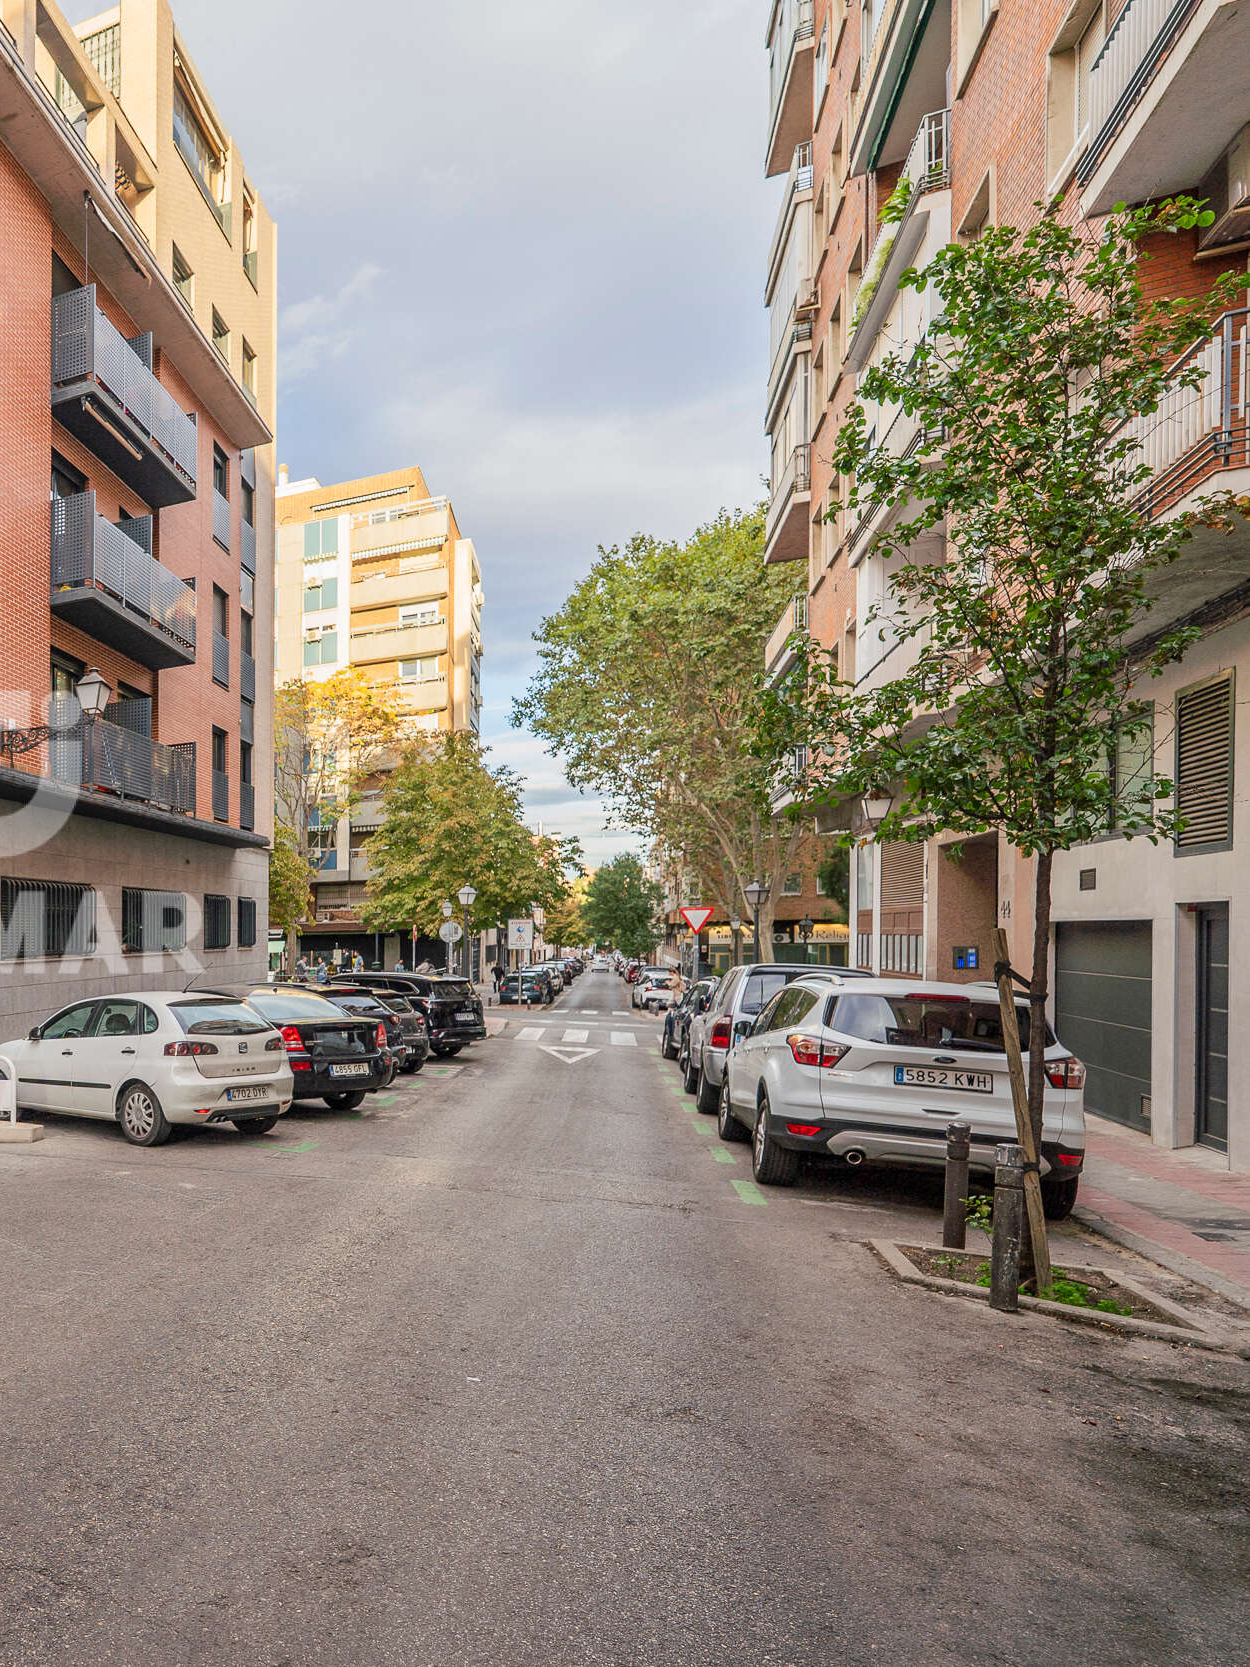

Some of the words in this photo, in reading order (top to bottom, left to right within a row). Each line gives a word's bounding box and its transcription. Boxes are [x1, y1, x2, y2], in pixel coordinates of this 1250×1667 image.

[334, 1064, 353, 1074] 4855
[906, 1069, 948, 1085] 5852
[954, 1073, 987, 1088] KWH
[231, 1088, 251, 1099] 4702
